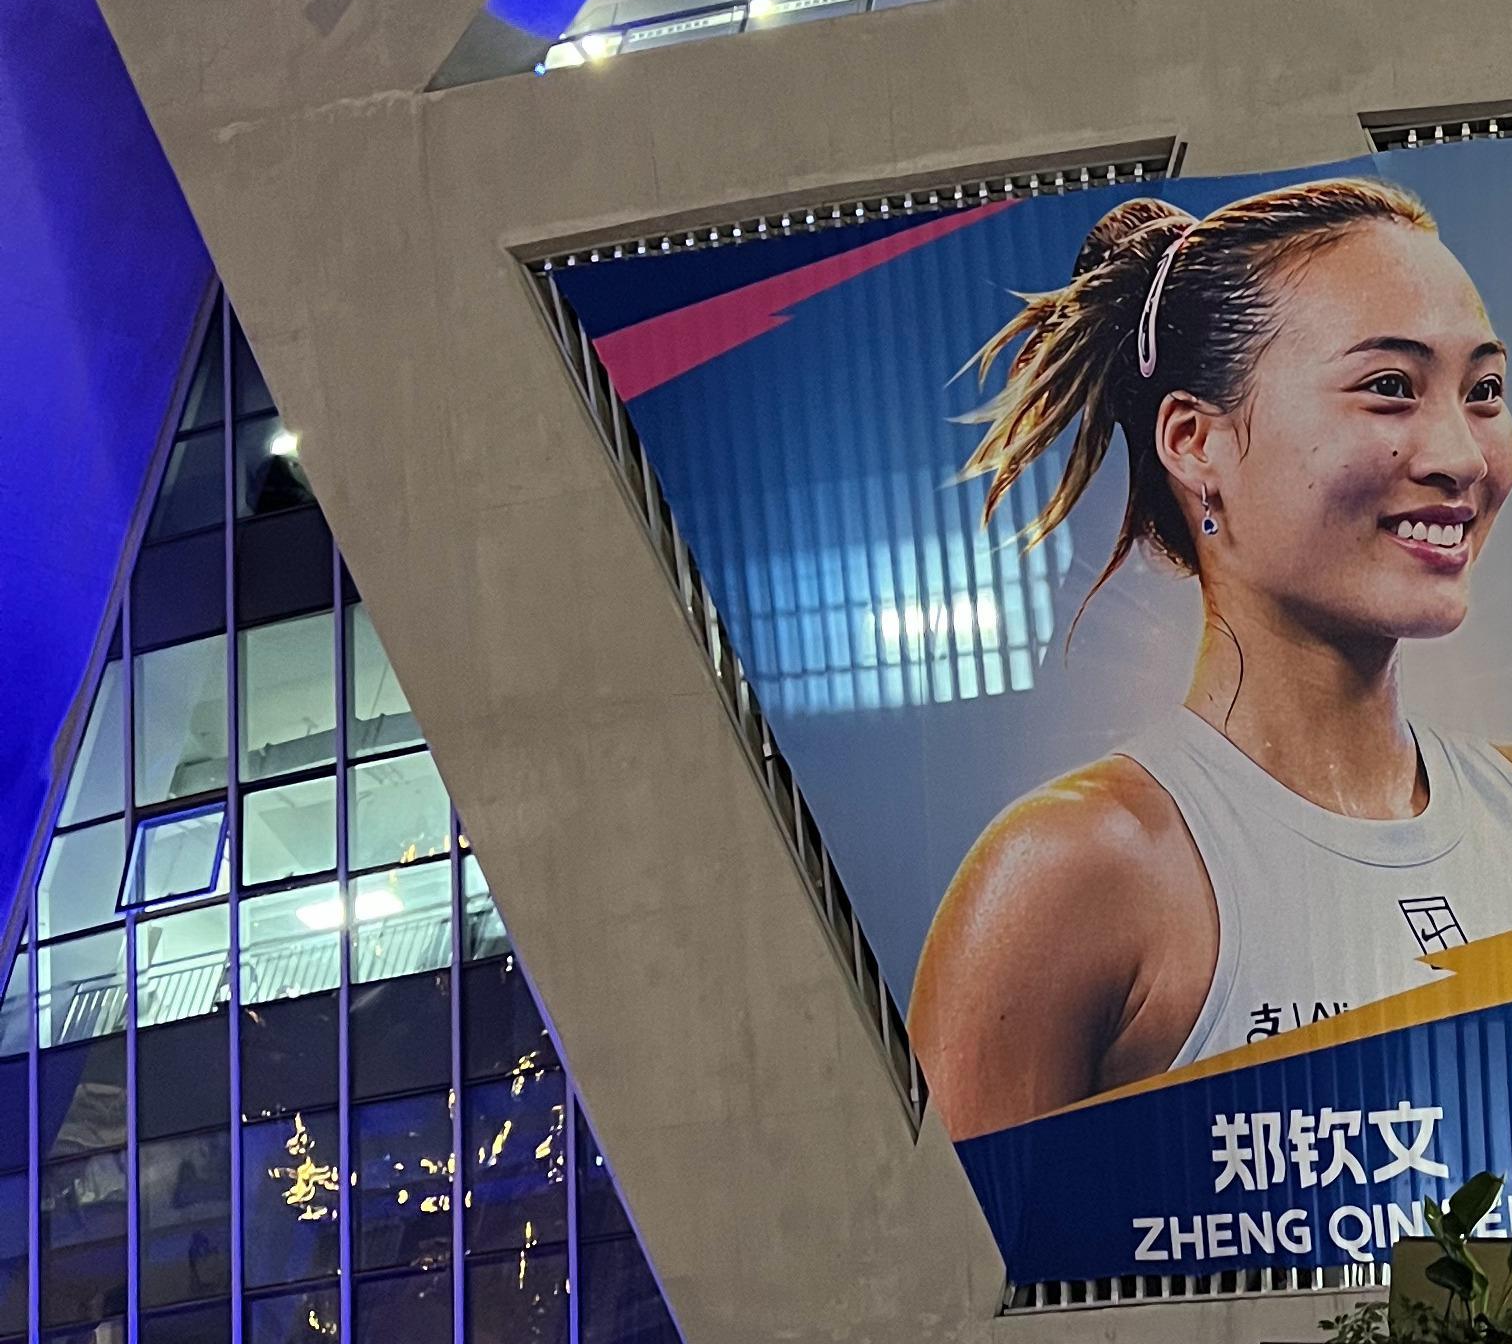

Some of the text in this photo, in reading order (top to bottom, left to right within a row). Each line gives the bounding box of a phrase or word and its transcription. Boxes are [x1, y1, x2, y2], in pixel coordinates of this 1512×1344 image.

[1211, 1101, 1450, 1193] 郑钦文
[1131, 1209, 1313, 1261] ZHENG
